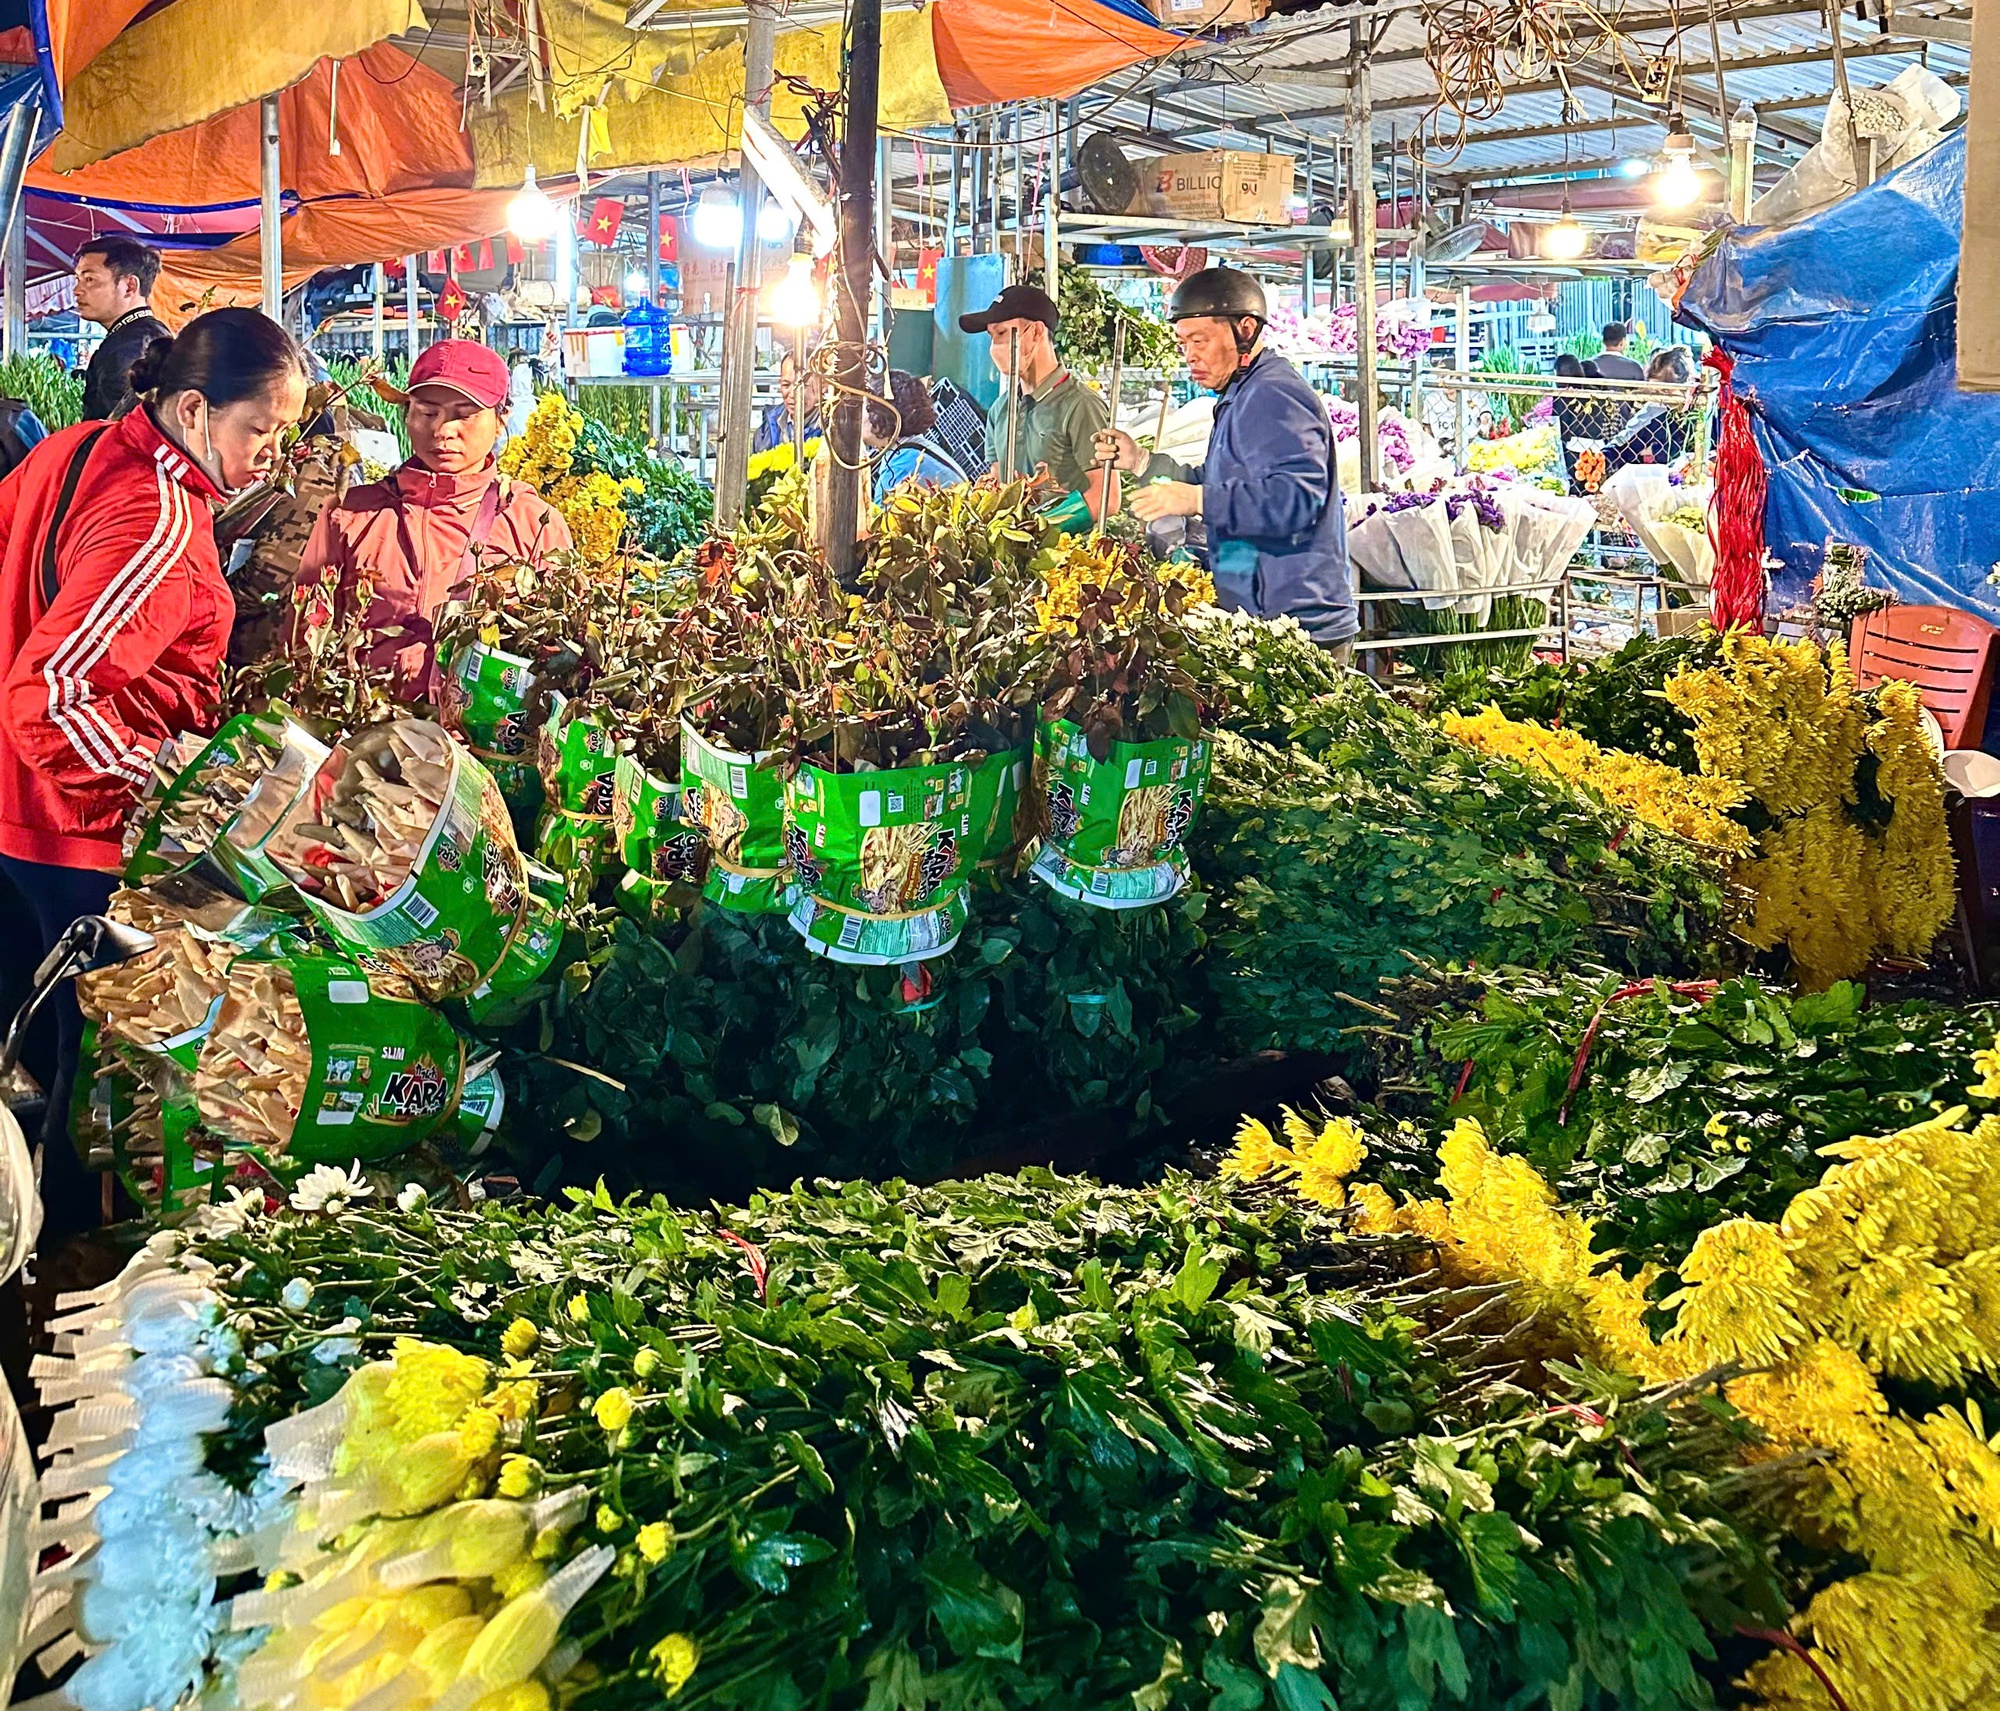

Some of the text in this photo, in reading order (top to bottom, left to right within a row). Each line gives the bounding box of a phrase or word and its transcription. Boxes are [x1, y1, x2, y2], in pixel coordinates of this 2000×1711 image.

[502, 667, 514, 692] KARA
[588, 729, 599, 754] KARA
[1056, 781, 1074, 832] KAR
[1080, 783, 1091, 806] SLIM
[814, 822, 826, 848] SLIM
[961, 814, 969, 836] SLIM
[927, 828, 956, 893] KARA
[381, 1046, 405, 1060] SLIM
[381, 1072, 449, 1110] KARA
